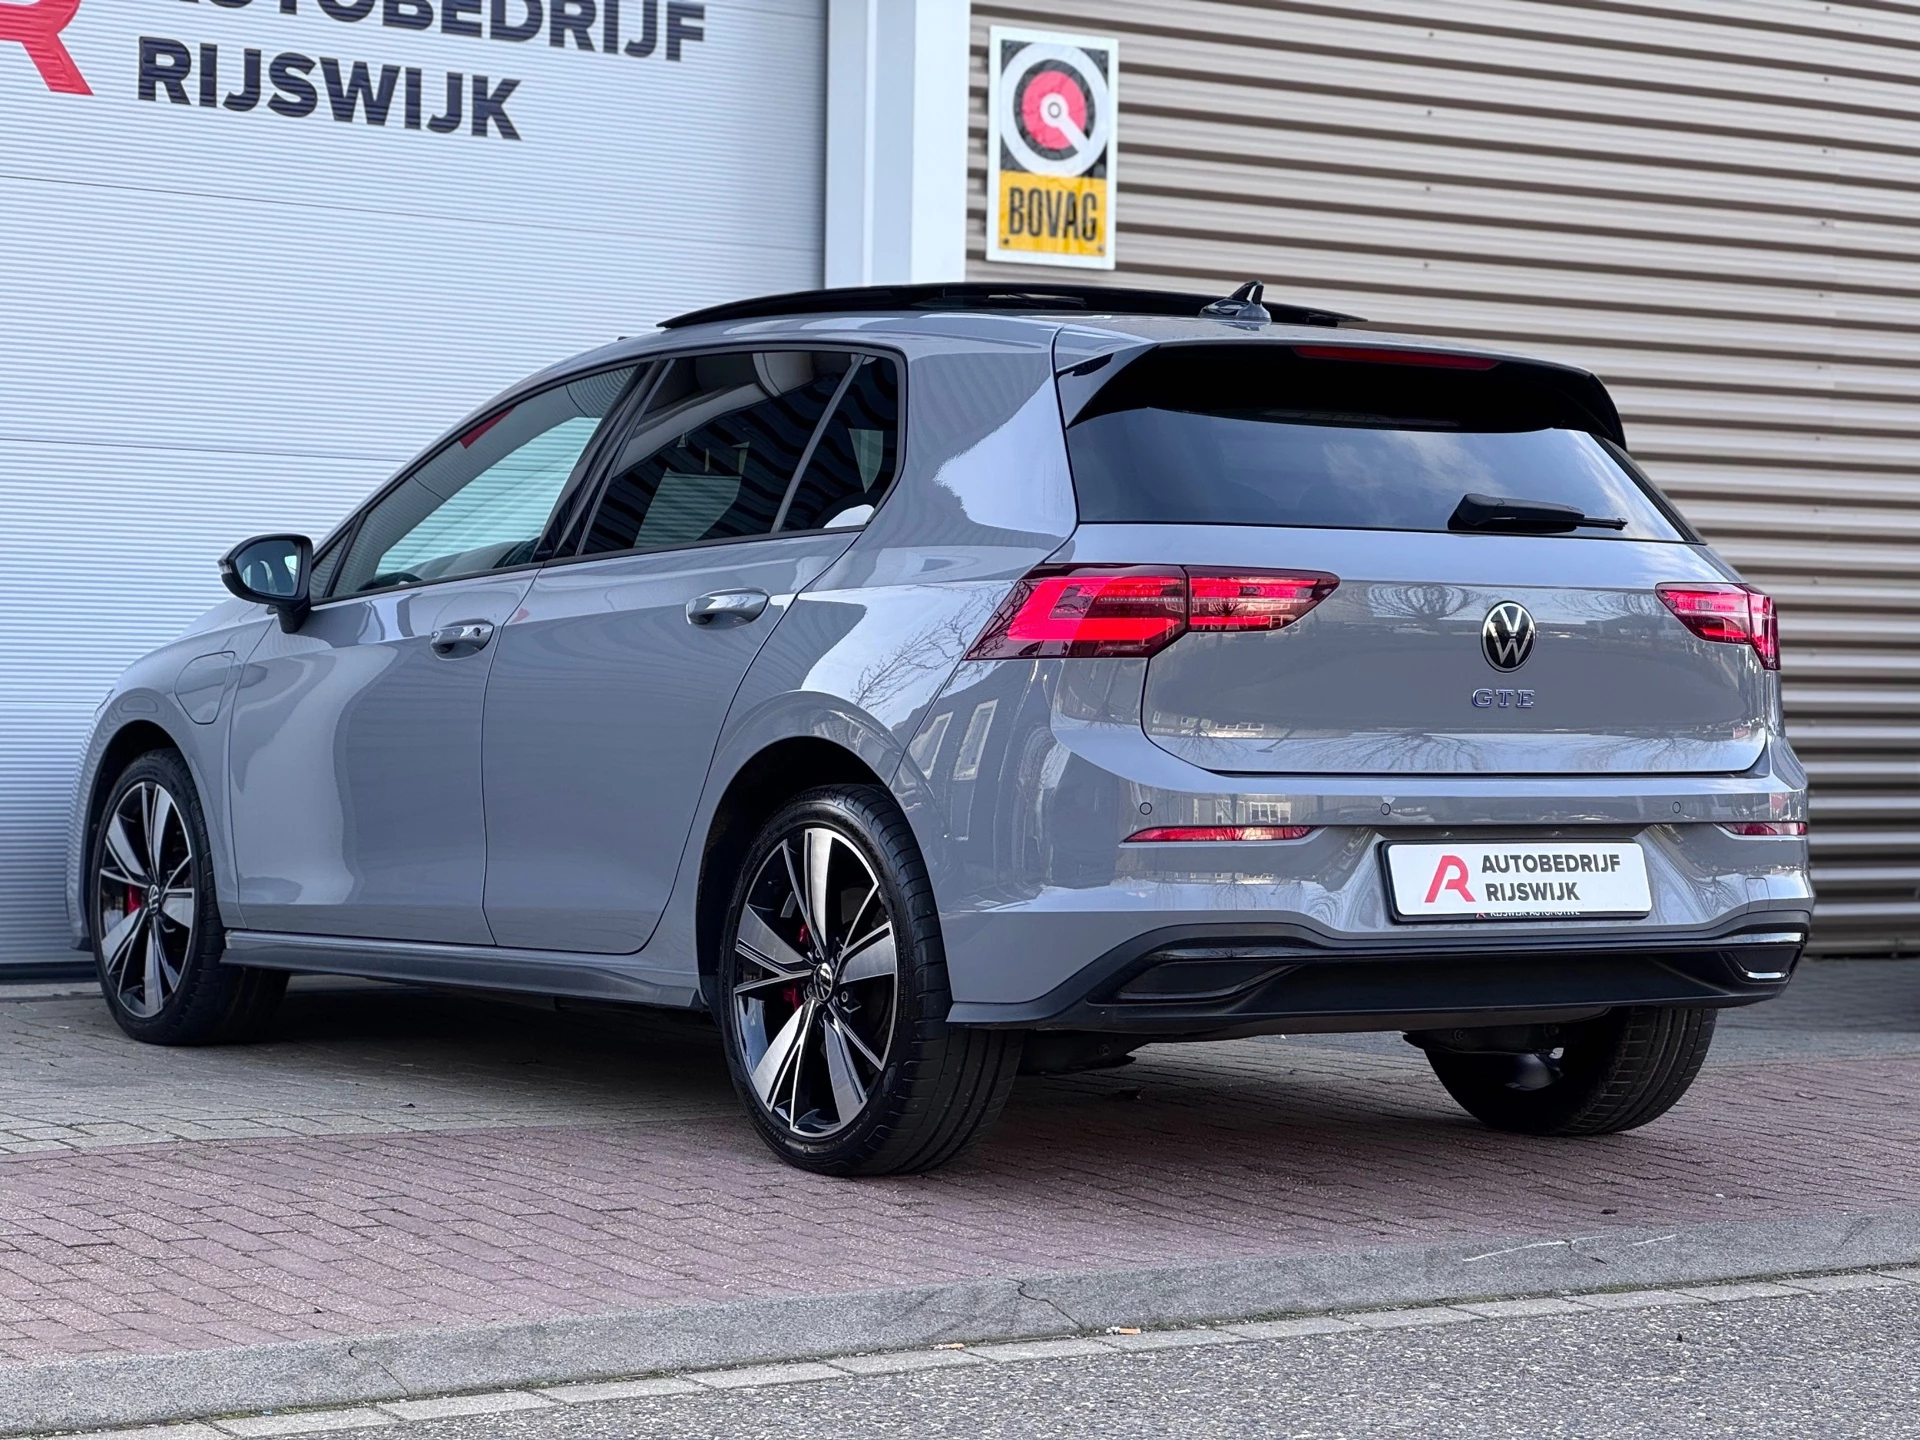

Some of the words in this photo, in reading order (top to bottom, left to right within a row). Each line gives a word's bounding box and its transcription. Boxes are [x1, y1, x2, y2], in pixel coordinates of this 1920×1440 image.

[137, 36, 521, 140] RIJSWIJK
[1008, 187, 1098, 242] BOVAG
[1471, 688, 1535, 708] GTE
[1481, 854, 1620, 873] AUTOBEDRIJF
[1485, 882, 1580, 901] RIJSWIJK
